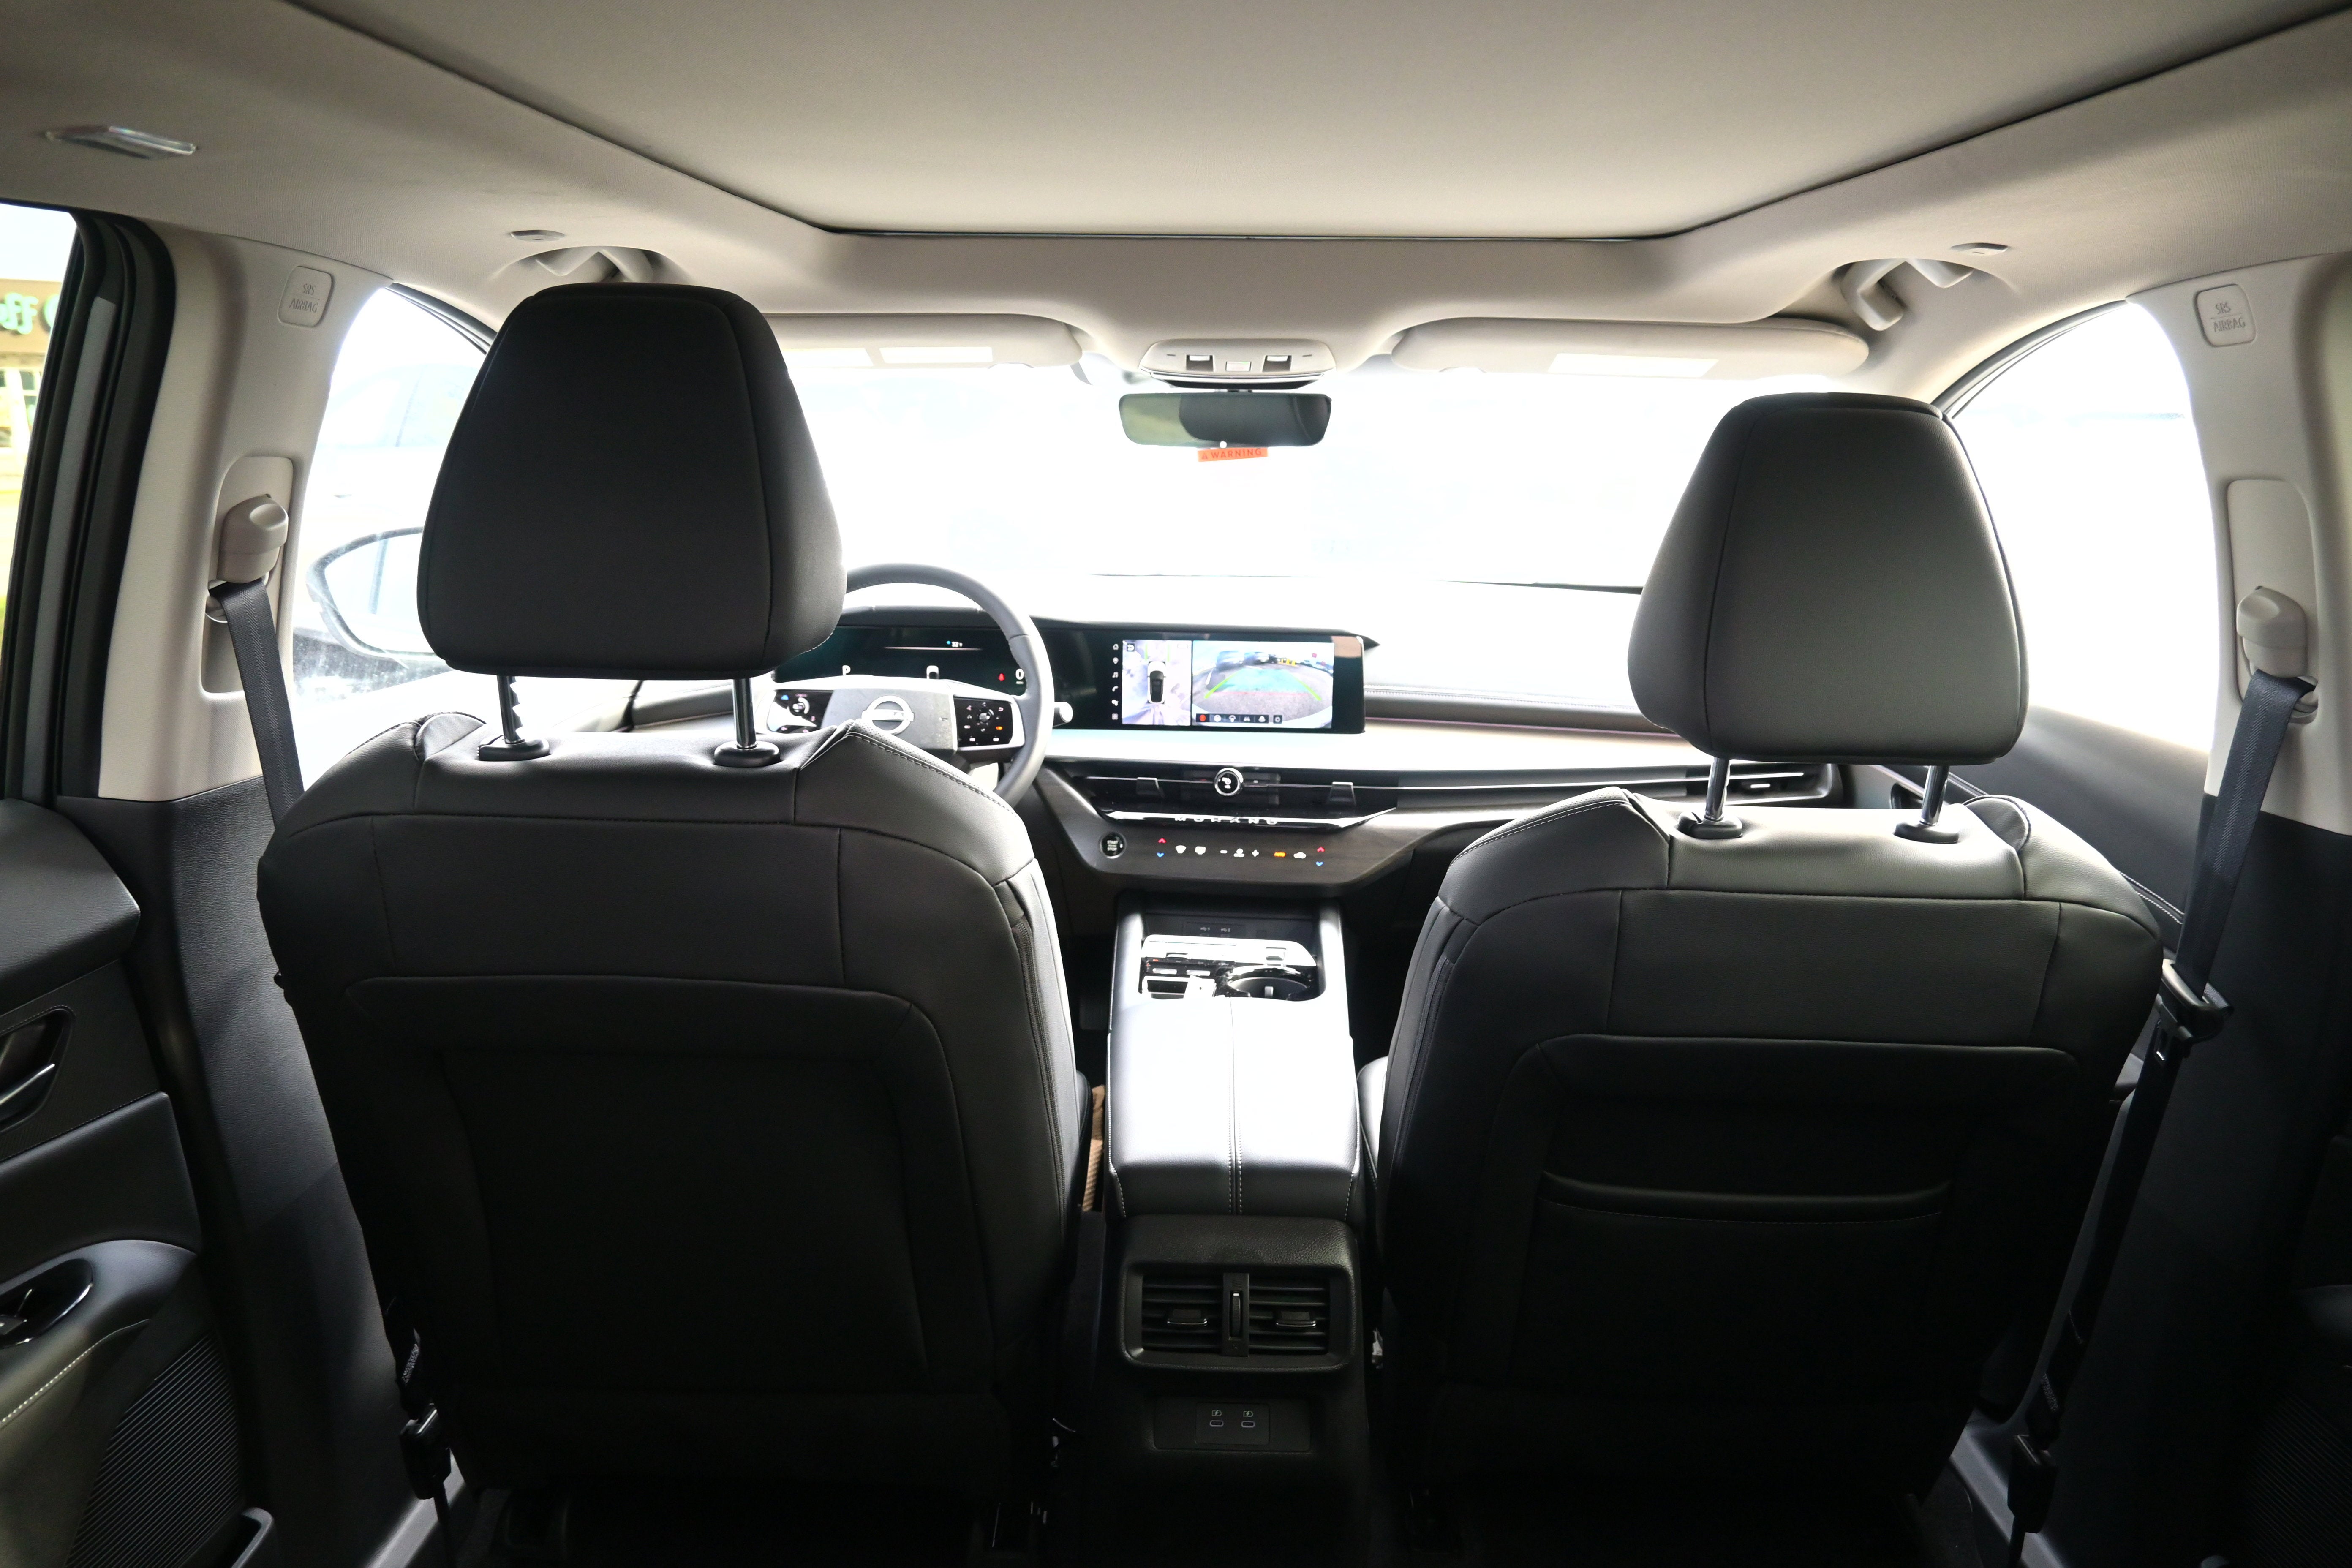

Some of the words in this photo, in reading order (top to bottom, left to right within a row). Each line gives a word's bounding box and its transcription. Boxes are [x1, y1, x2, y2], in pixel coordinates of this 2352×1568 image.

[302, 283, 316, 296] SRS
[289, 298, 318, 313] AIRBAG
[2215, 302, 2231, 315] SRS
[2213, 317, 2246, 332] AIRBAG
[1211, 448, 1262, 459] WARNING
[842, 665, 851, 675] P
[1015, 668, 1024, 680] 0
